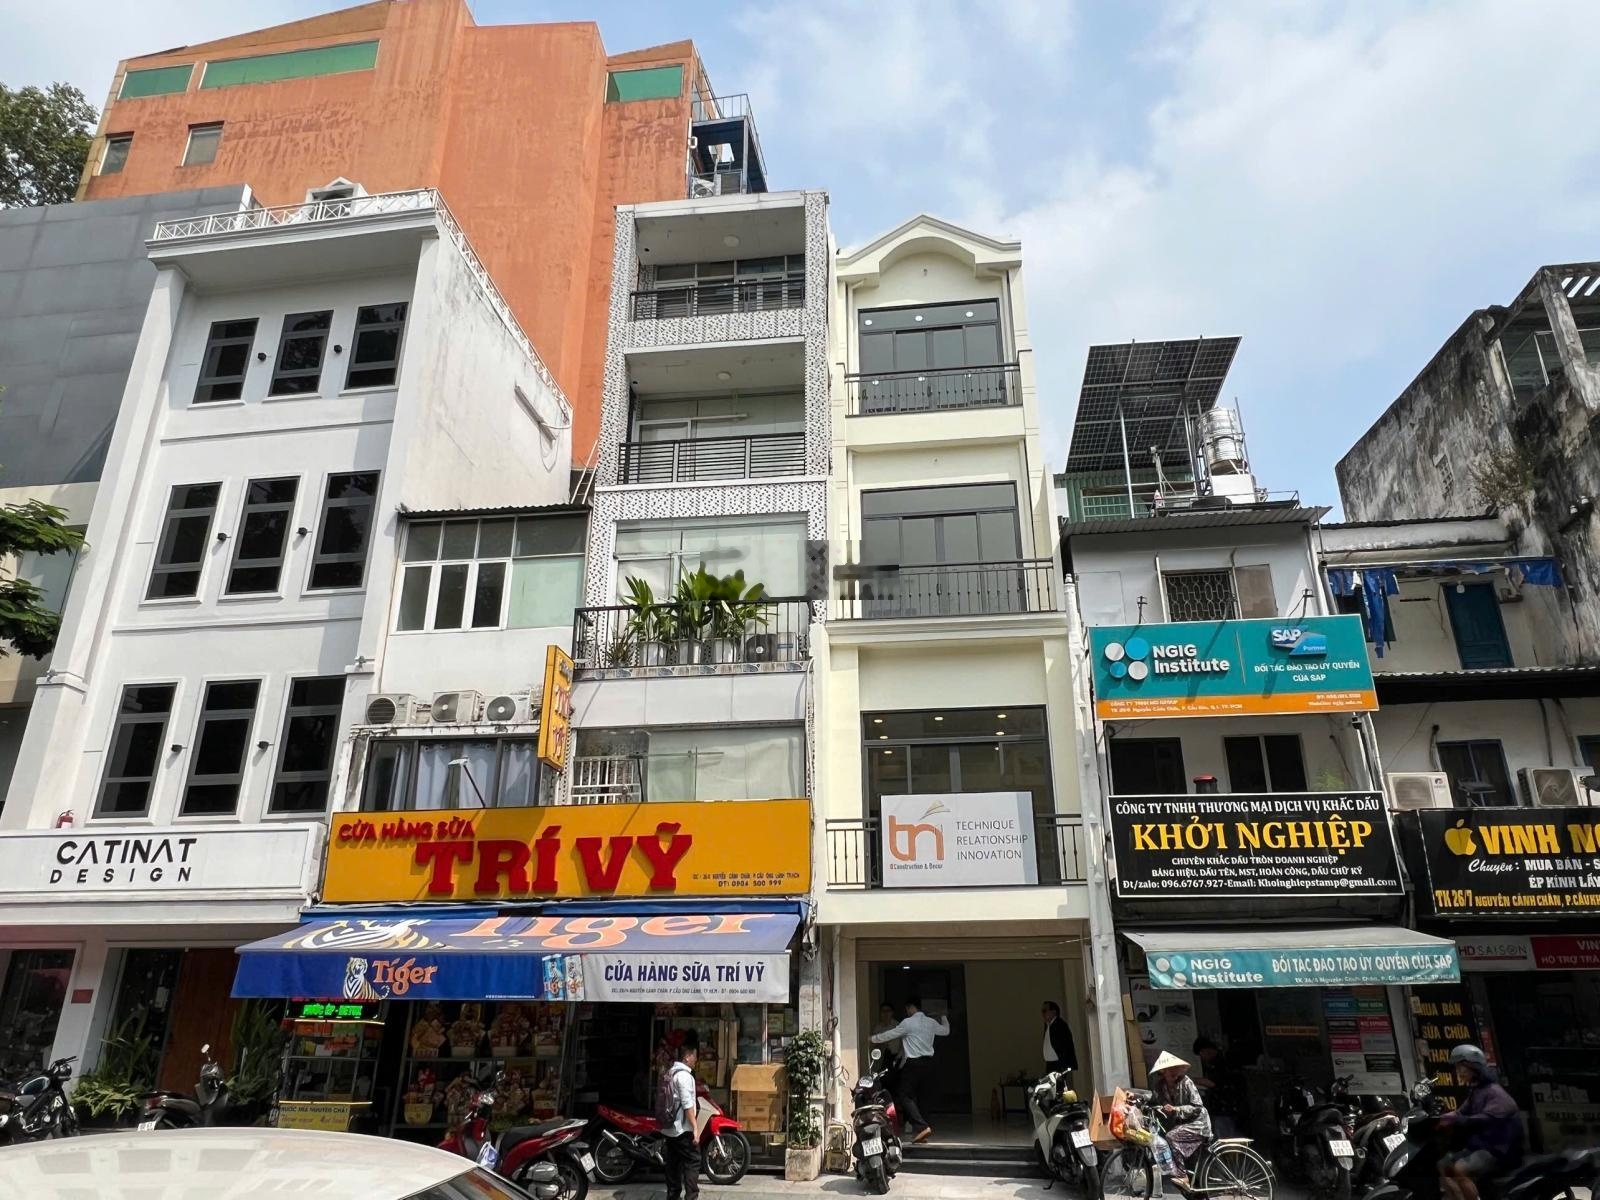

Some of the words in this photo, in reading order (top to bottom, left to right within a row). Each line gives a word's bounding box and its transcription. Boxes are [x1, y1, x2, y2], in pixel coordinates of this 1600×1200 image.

[1272, 629, 1301, 642] SAP
[1152, 643, 1197, 658] NGIG
[1154, 658, 1230, 673] Institute
[1310, 674, 1326, 682] SAP
[1116, 801, 1146, 814] CÔNG
[1147, 803, 1162, 814] TY
[1164, 802, 1196, 813] TNHH
[1198, 801, 1248, 813] THƯƠNG
[1251, 801, 1273, 814] MẠI
[1275, 800, 1302, 814] DỊCH
[1304, 800, 1320, 814] VỤ
[1322, 797, 1354, 811] KHẮC
[1356, 796, 1379, 810] DẤU
[338, 819, 377, 842] CỬA
[381, 818, 434, 839] HÀNG
[956, 820, 1015, 831] TECHNIQUE
[956, 835, 1028, 846] RELATIONSHIP
[1132, 815, 1228, 850] KHỞI
[1235, 813, 1372, 855] NGHIỆP
[1478, 824, 1561, 855] VINH
[56, 838, 198, 865] CATINAT
[415, 825, 562, 894] TRÍ
[576, 822, 692, 892] VỸ
[957, 850, 1022, 861] INNOVATION
[1171, 856, 1205, 865] CHUYÊN
[1231, 855, 1249, 864] DẤU
[1250, 855, 1274, 864] TRÒN
[1275, 856, 1305, 864] DOANH
[1306, 855, 1339, 865] NGHIỆP
[1524, 859, 1553, 871] MUA
[1555, 857, 1582, 871] BÁN
[50, 867, 191, 884] DESIGN
[1200, 866, 1217, 876] DẤU
[1218, 867, 1237, 877] TÊN,
[1239, 868, 1259, 877] MST,
[1259, 866, 1283, 876] HOÀN
[1123, 880, 1160, 890] Đt/zalo:
[1528, 875, 1544, 889] ÉP
[1545, 875, 1577, 889] KÍNH
[1458, 946, 1475, 956] HD
[1478, 944, 1528, 956] SAISON
[604, 960, 632, 982] CỬA
[637, 961, 678, 982] HÀNG
[682, 961, 711, 982] SỮA
[716, 961, 740, 982] TRÍ
[745, 961, 765, 982] VỸ
[1190, 958, 1232, 970] NGIG
[1272, 955, 1292, 972] ĐỐI
[1293, 956, 1311, 972] TÁC
[1337, 955, 1358, 974] TẠO
[1433, 954, 1452, 969] SAP
[372, 957, 438, 995] Tiger
[1191, 972, 1263, 984] Institute
